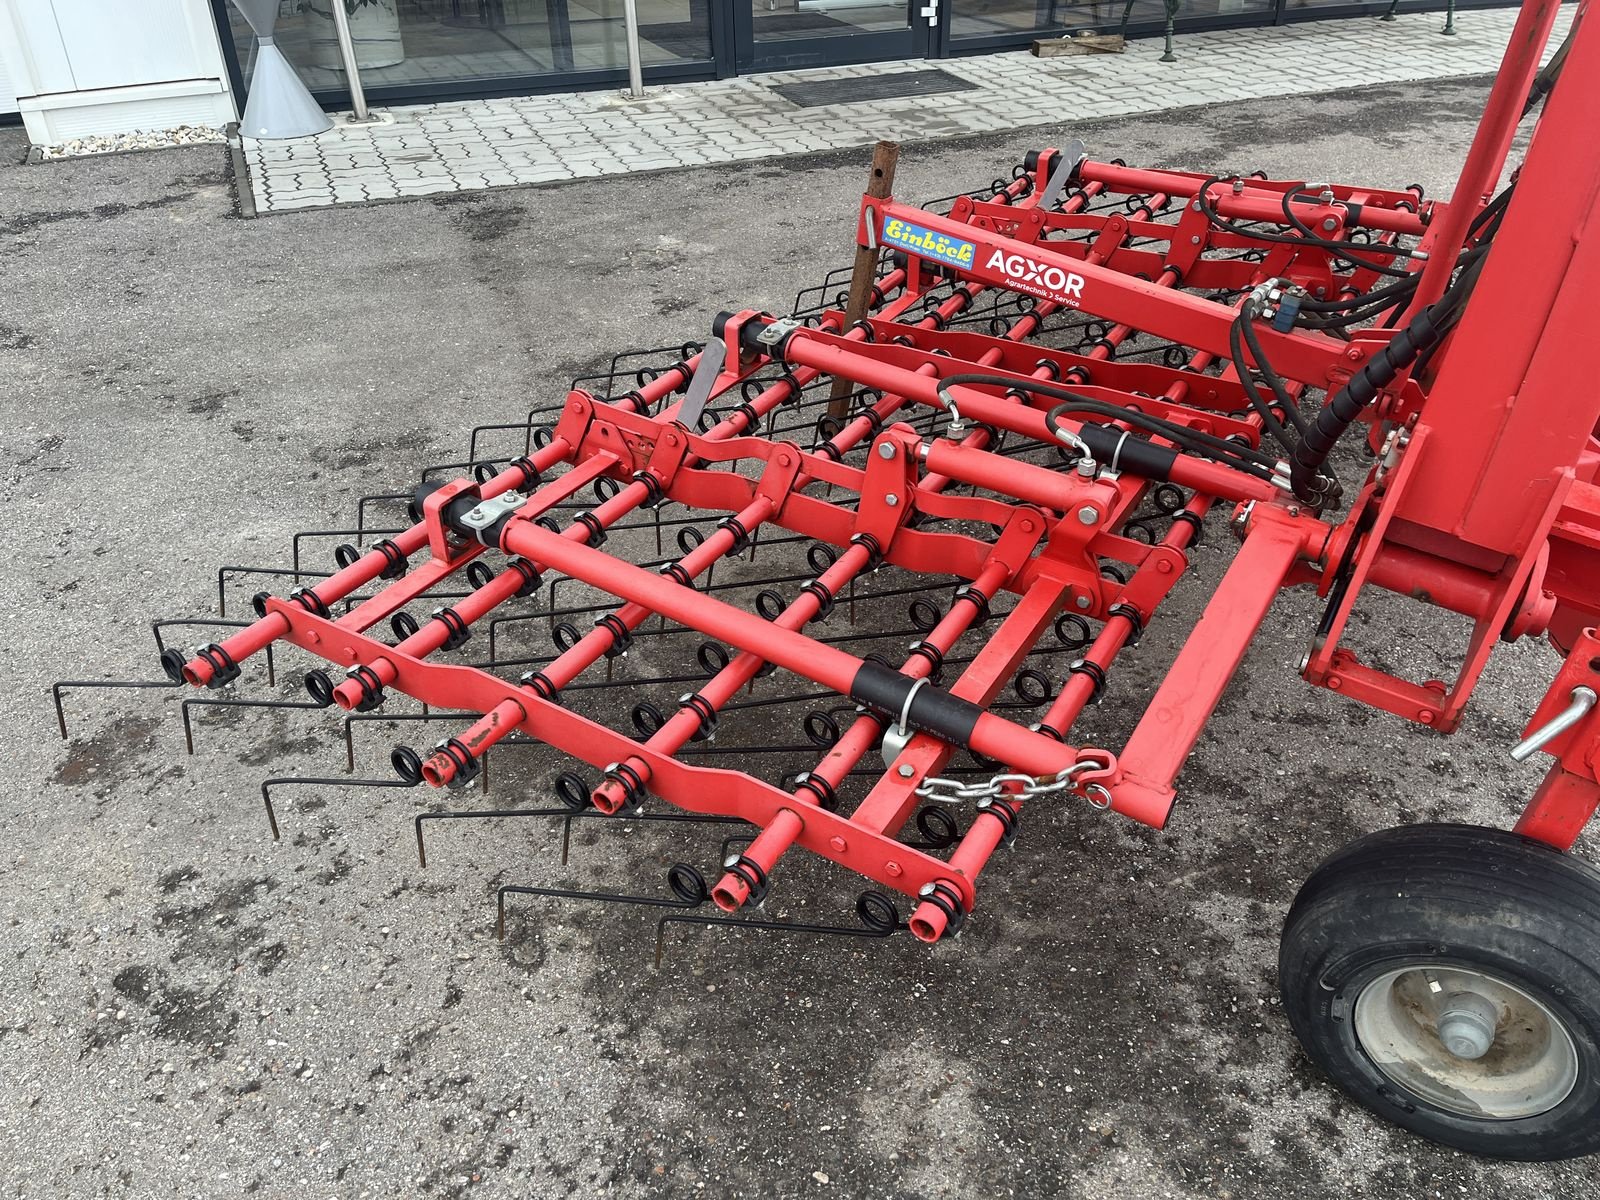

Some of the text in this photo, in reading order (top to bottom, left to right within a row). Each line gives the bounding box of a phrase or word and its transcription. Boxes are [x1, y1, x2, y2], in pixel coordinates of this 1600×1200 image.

[885, 219, 973, 263] Einböck
[985, 249, 1085, 298] AGXOR
[1004, 278, 1080, 308] Agrartechnik Service
